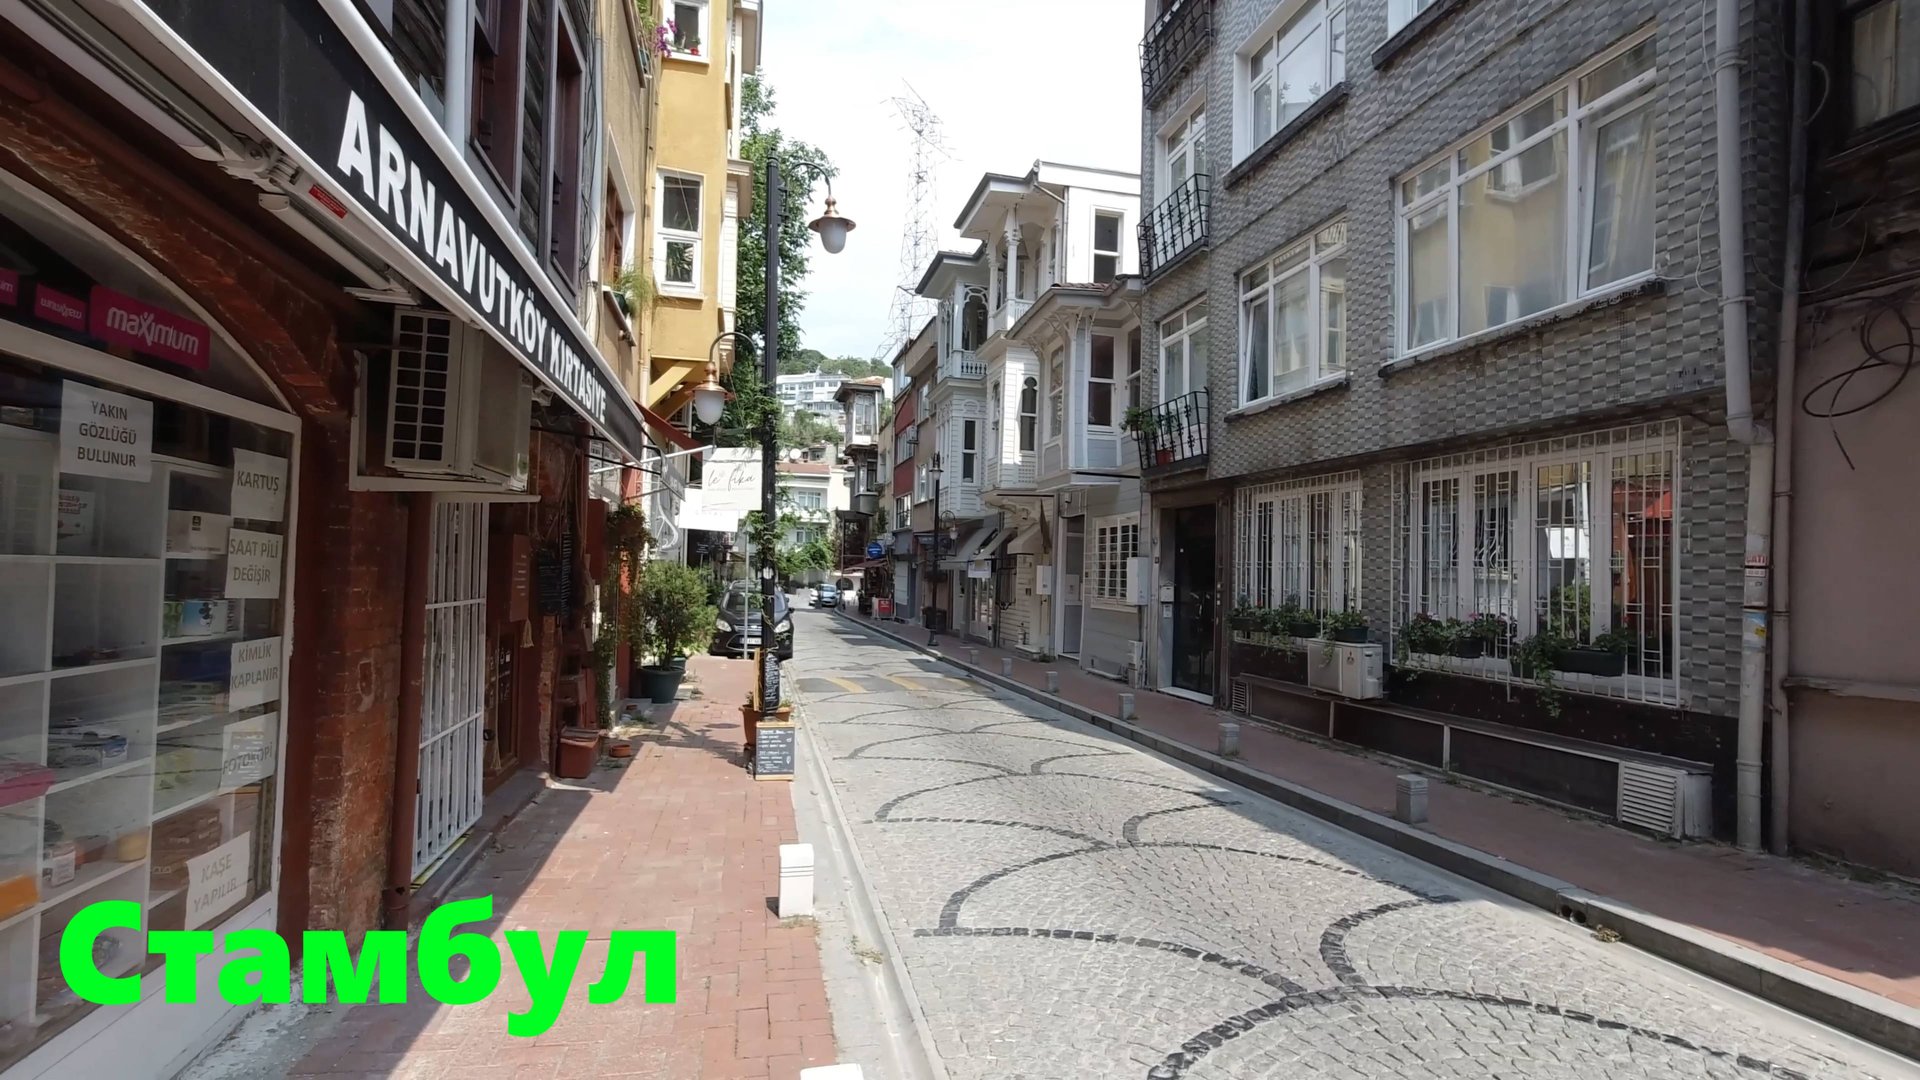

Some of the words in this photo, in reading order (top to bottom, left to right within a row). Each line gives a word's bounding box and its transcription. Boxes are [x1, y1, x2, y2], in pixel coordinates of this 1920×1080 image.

[337, 90, 547, 364] ARNAVUTKÖY
[549, 327, 607, 425] KIRTASİYE
[91, 400, 128, 421] YAKIN
[79, 422, 137, 446] GÖZLÜĞÜ
[77, 446, 136, 467] BULUNUR
[236, 470, 280, 494] KARTUŞ
[229, 538, 257, 556] SAAT
[260, 539, 279, 559] PİLİ
[232, 563, 271, 585] DEĞİŞİR
[238, 643, 273, 663] KİMLİK
[230, 666, 279, 690] KAPLANIR
[200, 852, 232, 884] KAŞE
[193, 877, 238, 913] YAPILIR
